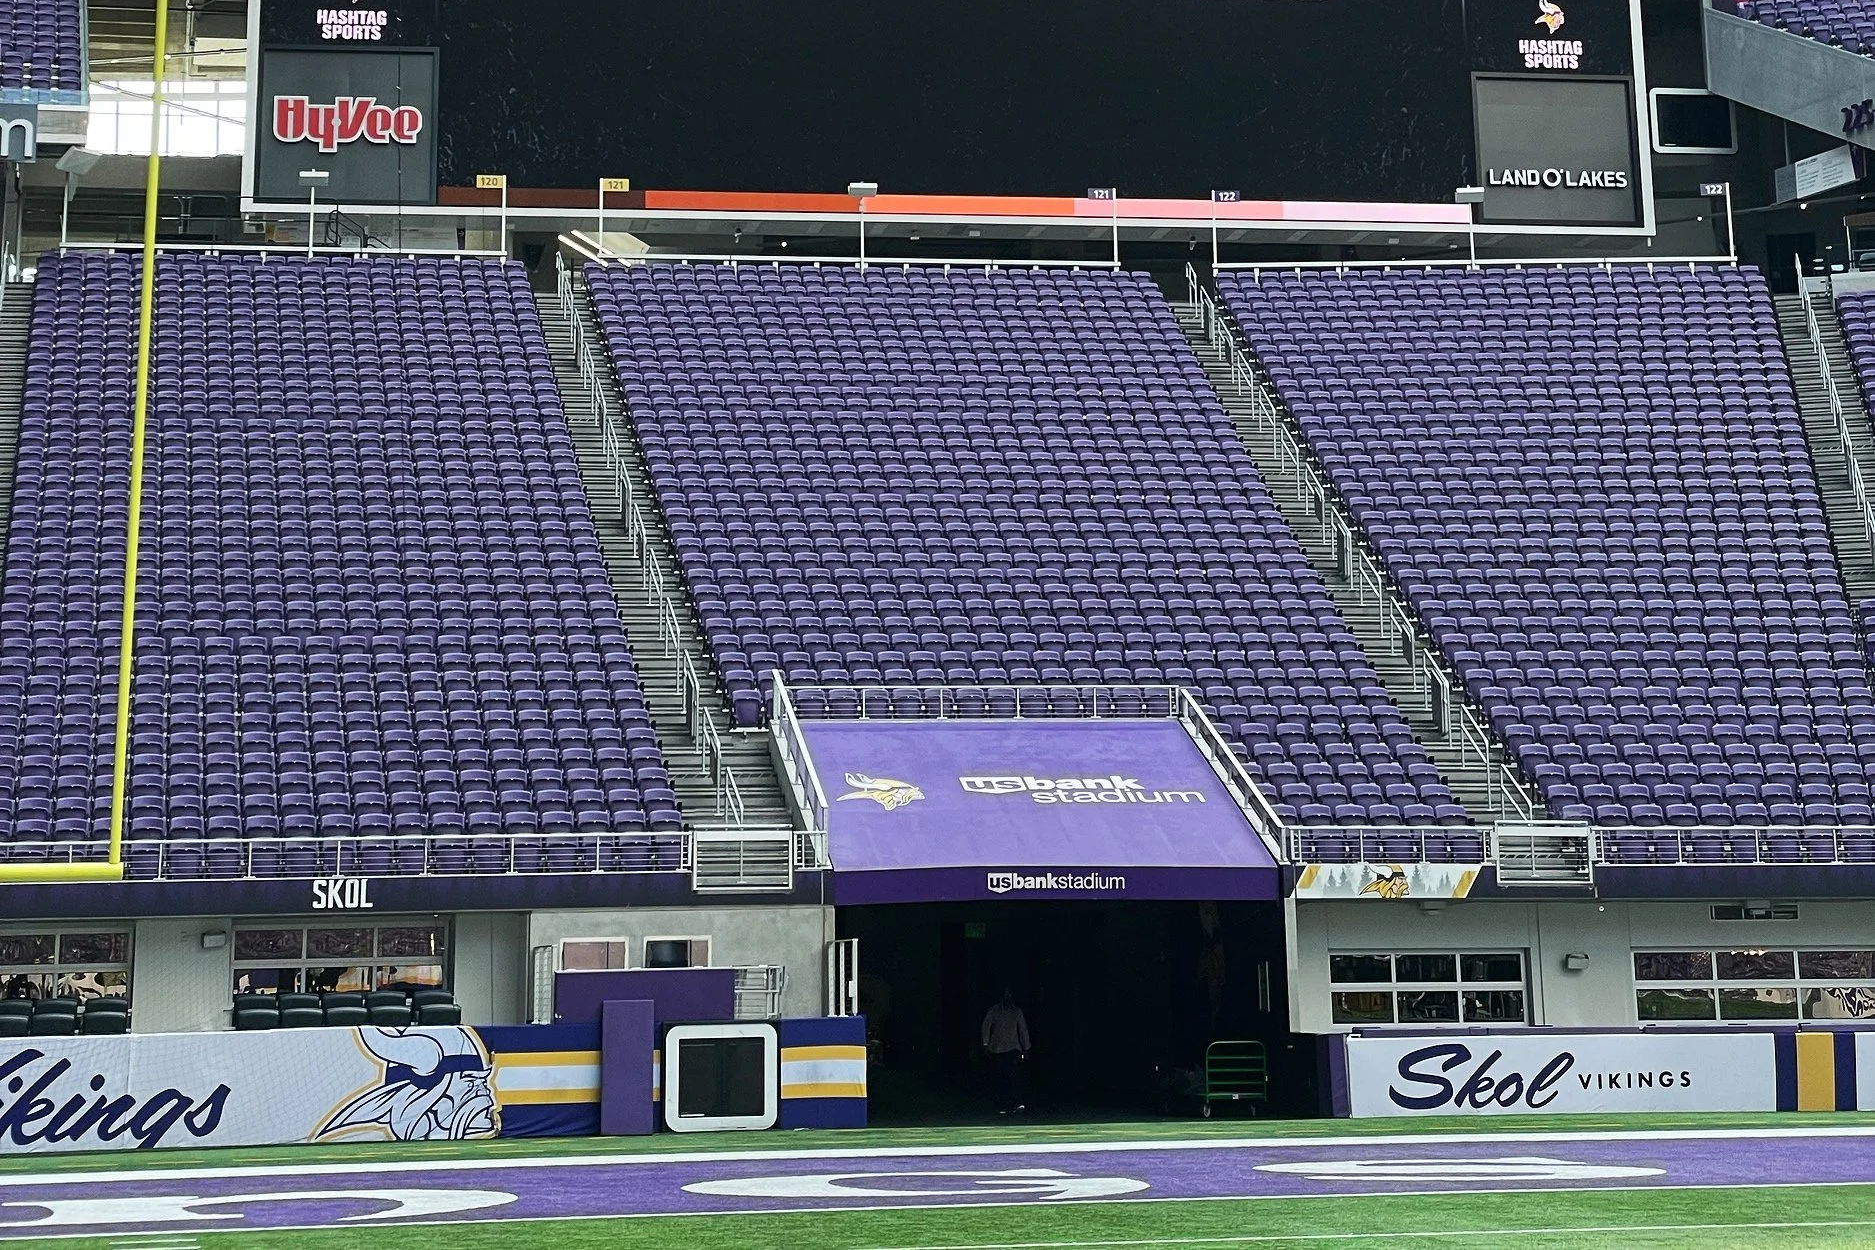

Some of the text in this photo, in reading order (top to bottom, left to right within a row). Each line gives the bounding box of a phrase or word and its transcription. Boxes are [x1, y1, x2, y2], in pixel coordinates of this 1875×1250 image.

[316, 9, 388, 26] HASHTAG
[321, 24, 382, 41] SPORTS
[1518, 39, 1583, 55] HASHTAG
[1524, 54, 1579, 69] SPORTS
[480, 177, 498, 186] 120
[608, 180, 624, 189] 121
[1488, 168, 1541, 186] LAND
[1093, 189, 1109, 199] 121
[1218, 191, 1236, 201] 122
[1704, 185, 1723, 194] 122
[1033, 788, 1207, 804] stadium
[312, 878, 374, 909] SKOL
[1389, 1042, 1692, 1110] Skol VIKINGS
